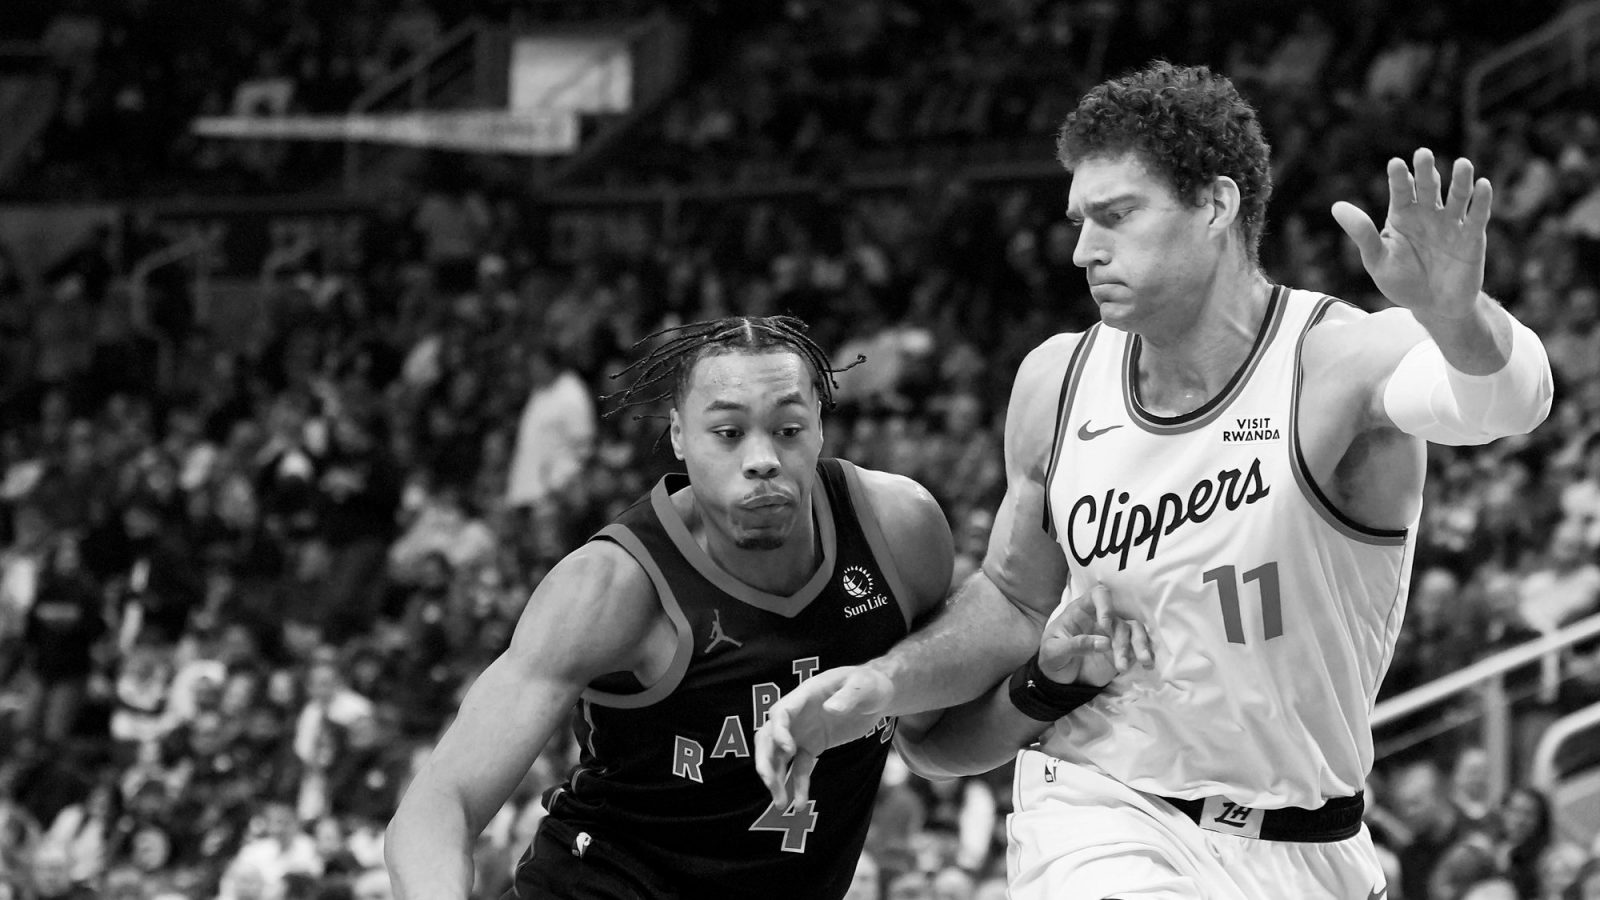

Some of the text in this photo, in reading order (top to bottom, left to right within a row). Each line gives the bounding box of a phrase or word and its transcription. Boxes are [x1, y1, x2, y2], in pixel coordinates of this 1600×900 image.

[1223, 429, 1280, 442] RWANDA
[1236, 417, 1271, 430] VISIT
[1067, 457, 1271, 571] Clippers
[843, 593, 889, 619] Sun Life
[1203, 561, 1283, 645] 11
[749, 757, 819, 853] 4
